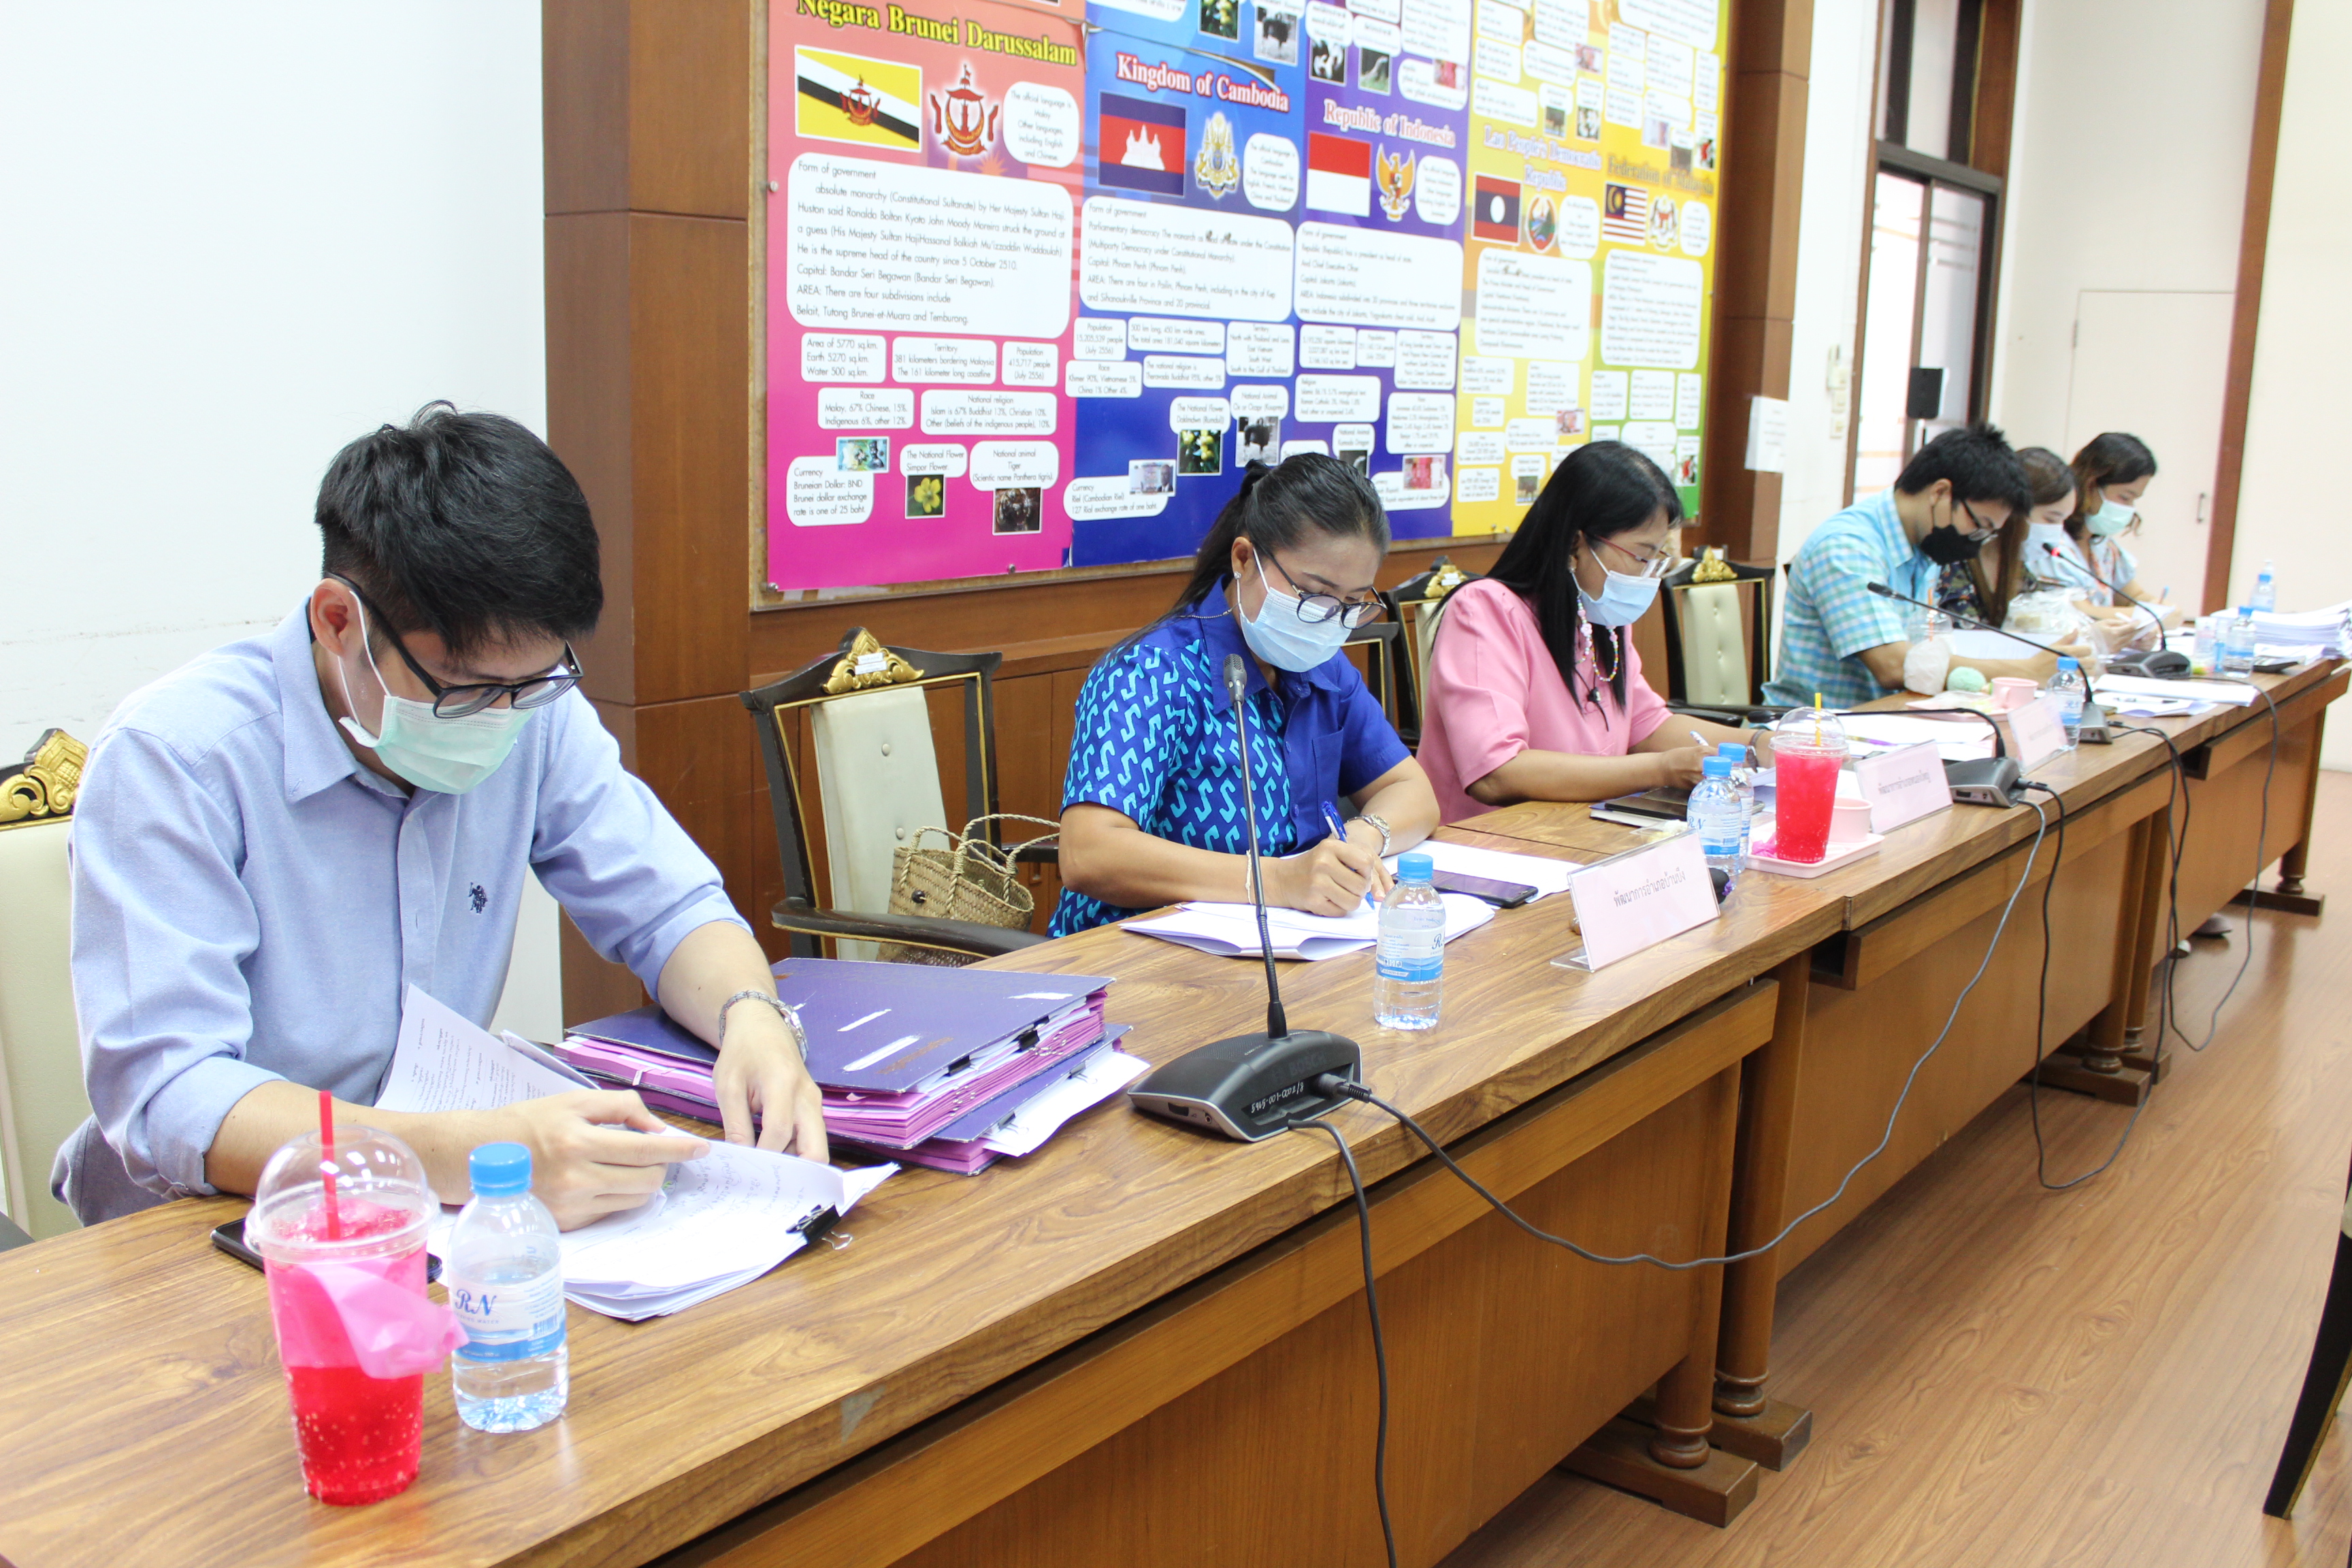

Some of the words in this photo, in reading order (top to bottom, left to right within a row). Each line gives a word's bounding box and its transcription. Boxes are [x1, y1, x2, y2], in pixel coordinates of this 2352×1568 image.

[887, 3, 960, 45] Brunei
[966, 20, 1077, 66] Darussalam
[1116, 52, 1192, 92] Kingdom
[1196, 71, 1213, 97] of
[1217, 75, 1290, 113] Cambodia
[1325, 99, 1382, 131] Republic
[1384, 115, 1398, 135] of
[1401, 116, 1456, 148] Indonesia
[798, 160, 817, 172] Form
[821, 162, 829, 173] of
[832, 167, 876, 179] government
[797, 243, 808, 254] He
[812, 245, 817, 254] is
[821, 244, 832, 255] the
[836, 248, 866, 259] supreme
[870, 248, 887, 260] head
[891, 250, 898, 261] of
[901, 251, 911, 262] the
[914, 255, 939, 267] country
[943, 255, 960, 265] since
[962, 257, 966, 266] 5
[969, 257, 996, 268] October
[797, 263, 827, 278] Capital:
[830, 265, 858, 278] Bandar
[861, 268, 875, 278] Seri
[878, 270, 911, 282] Begawan
[914, 272, 941, 284] (Bandar
[945, 274, 957, 284] Seri
[797, 284, 821, 295] AREA:
[825, 284, 845, 297] There
[849, 290, 861, 298] are
[864, 287, 879, 299] four
[881, 289, 924, 301] subdivisions
[926, 291, 951, 303] include
[823, 306, 848, 320] Tutong
[913, 309, 926, 321] and
[860, 391, 875, 399] Race
[794, 468, 823, 478] Currency
